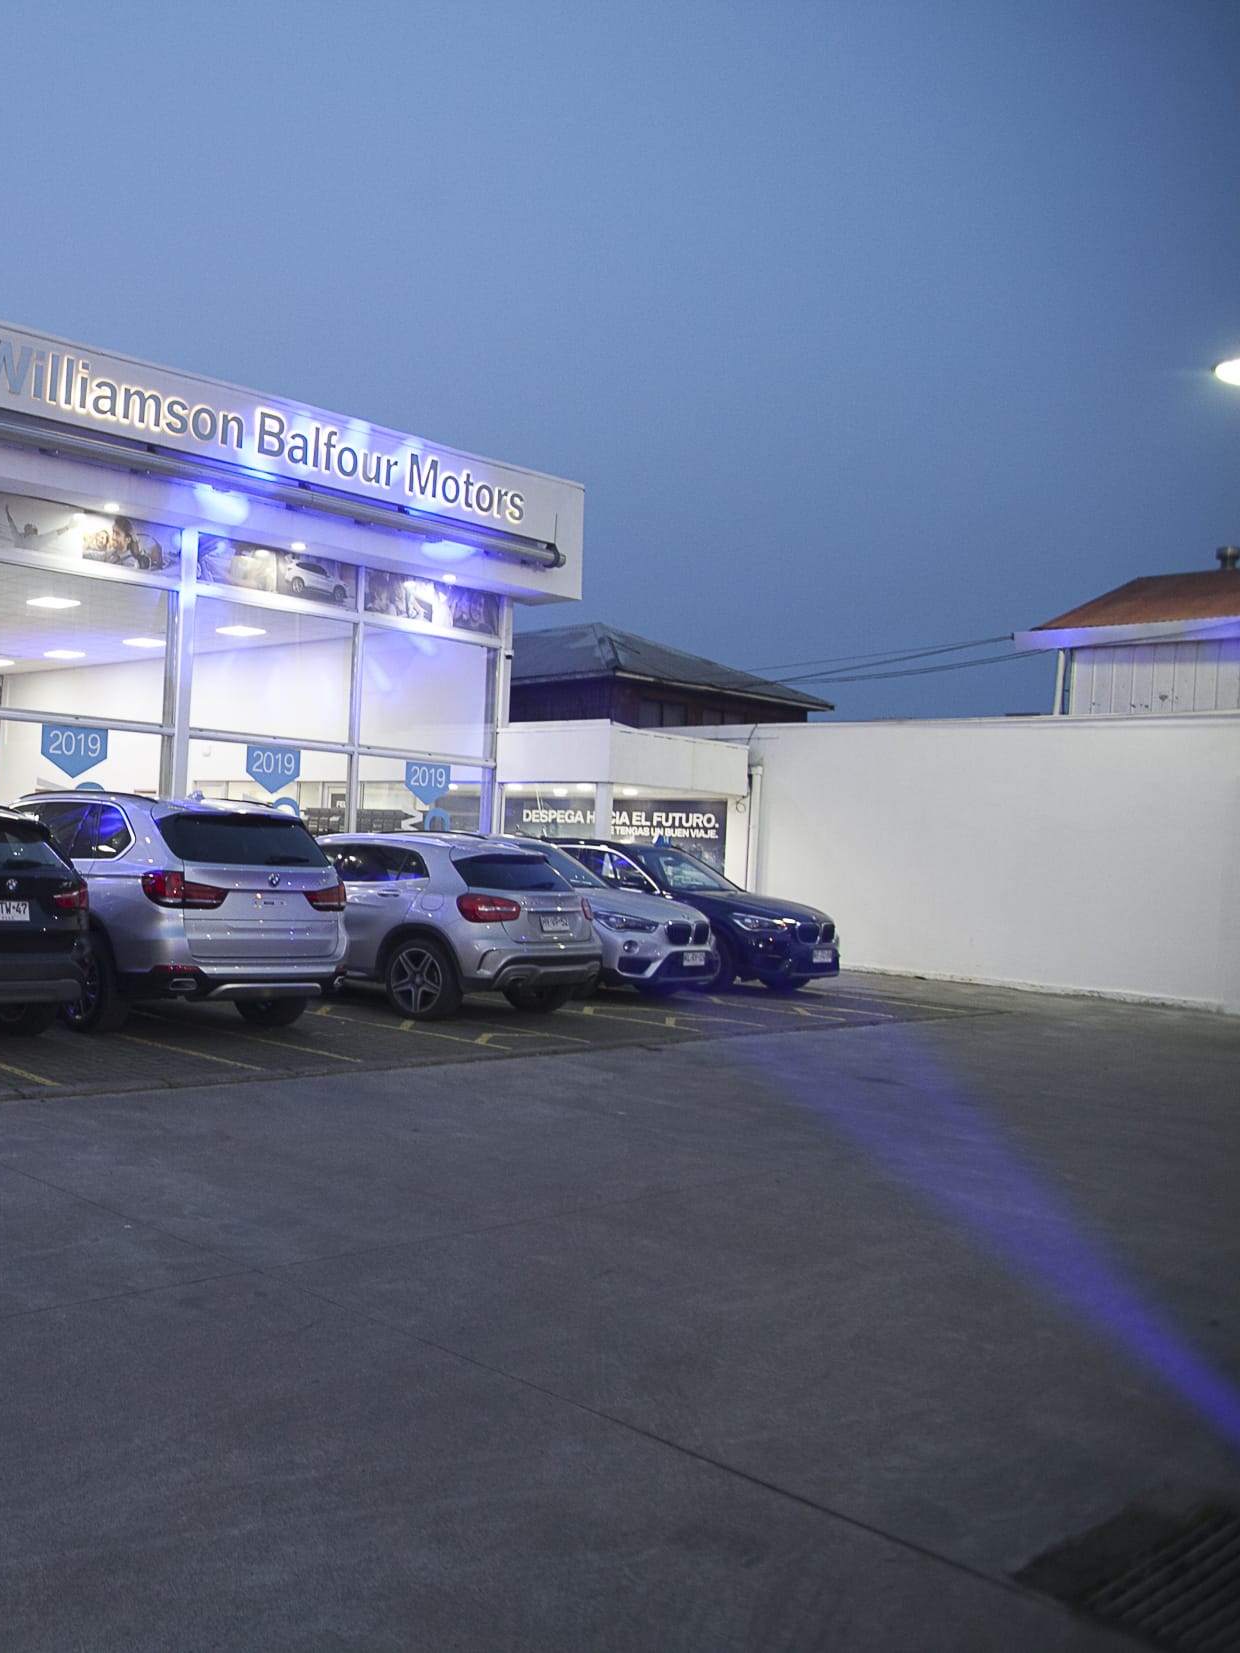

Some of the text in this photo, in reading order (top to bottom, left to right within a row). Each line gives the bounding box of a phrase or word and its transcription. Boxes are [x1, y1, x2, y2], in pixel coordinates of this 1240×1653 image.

[258, 411, 398, 487] Balfour
[408, 453, 525, 522] Motors
[49, 731, 101, 757] 2019
[252, 751, 295, 775] 2019
[410, 766, 446, 788] 2019
[523, 808, 585, 825] DESPEGA
[632, 811, 651, 827] EL
[652, 811, 720, 828] FUTURO.
[615, 826, 650, 837] TENGAS
[651, 827, 664, 837] UN
[665, 828, 690, 838] BUEN
[690, 829, 719, 840] VIAJE.
